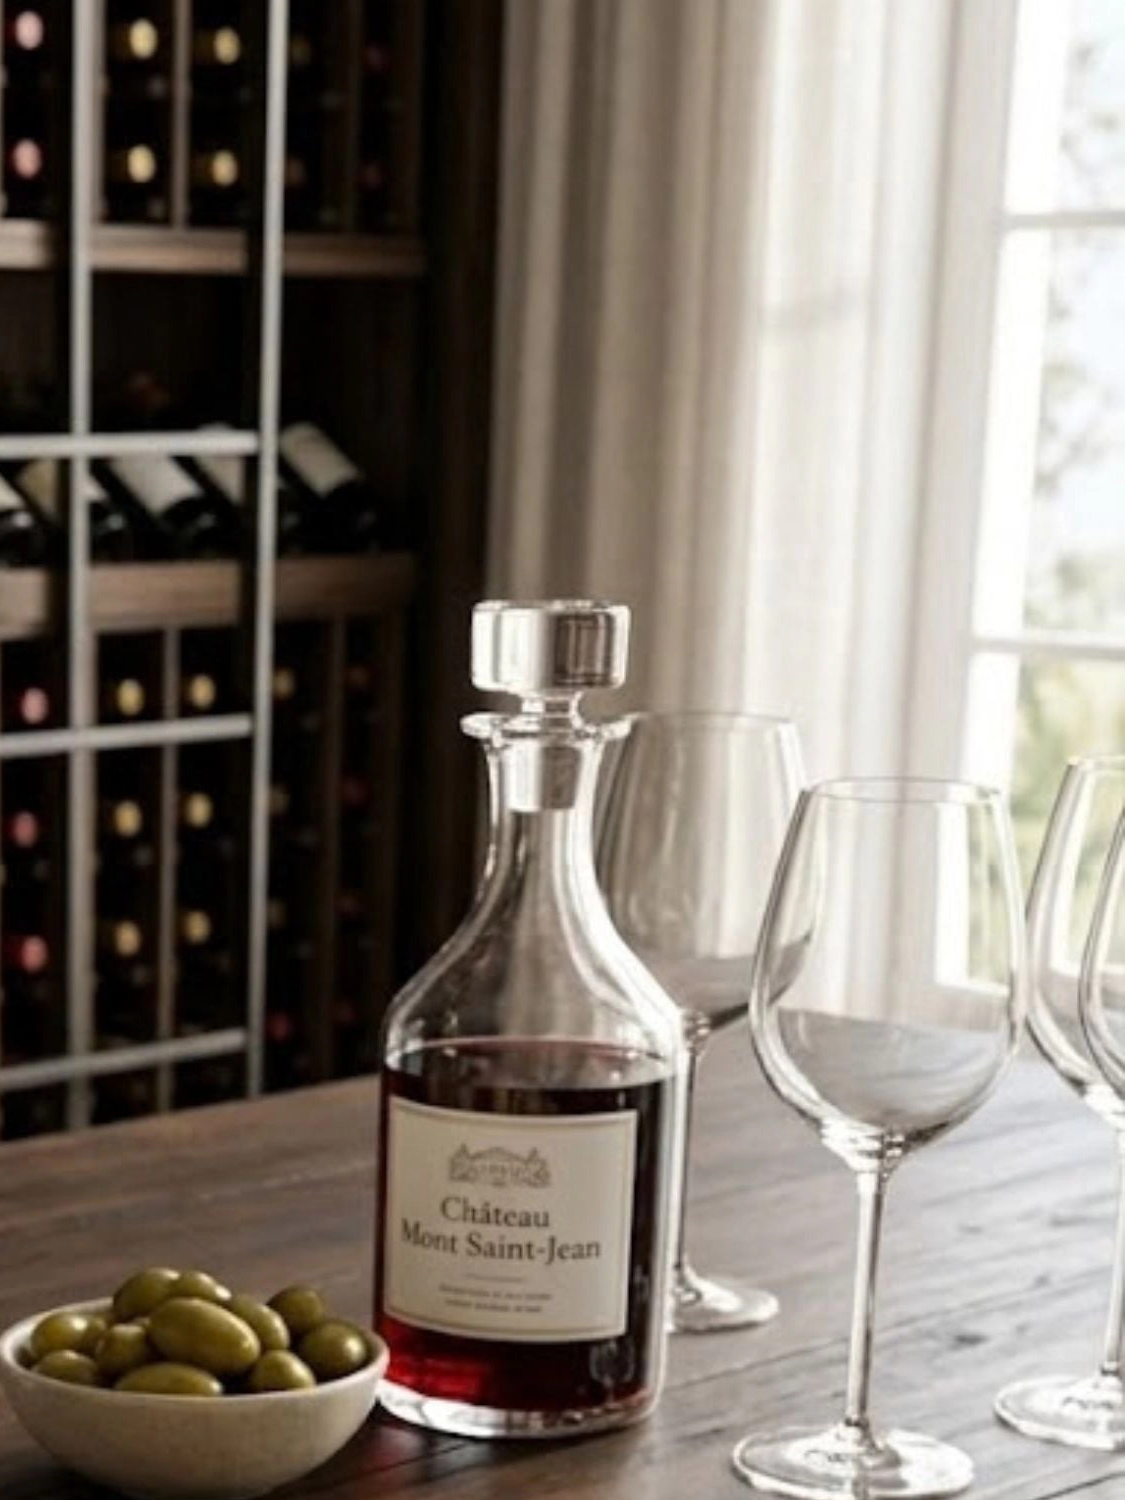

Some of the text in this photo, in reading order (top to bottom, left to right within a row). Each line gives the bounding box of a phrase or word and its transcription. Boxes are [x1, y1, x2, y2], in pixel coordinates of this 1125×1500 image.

[440, 1196, 550, 1228] Château
[401, 1217, 601, 1265] Mont Saint-Jean
